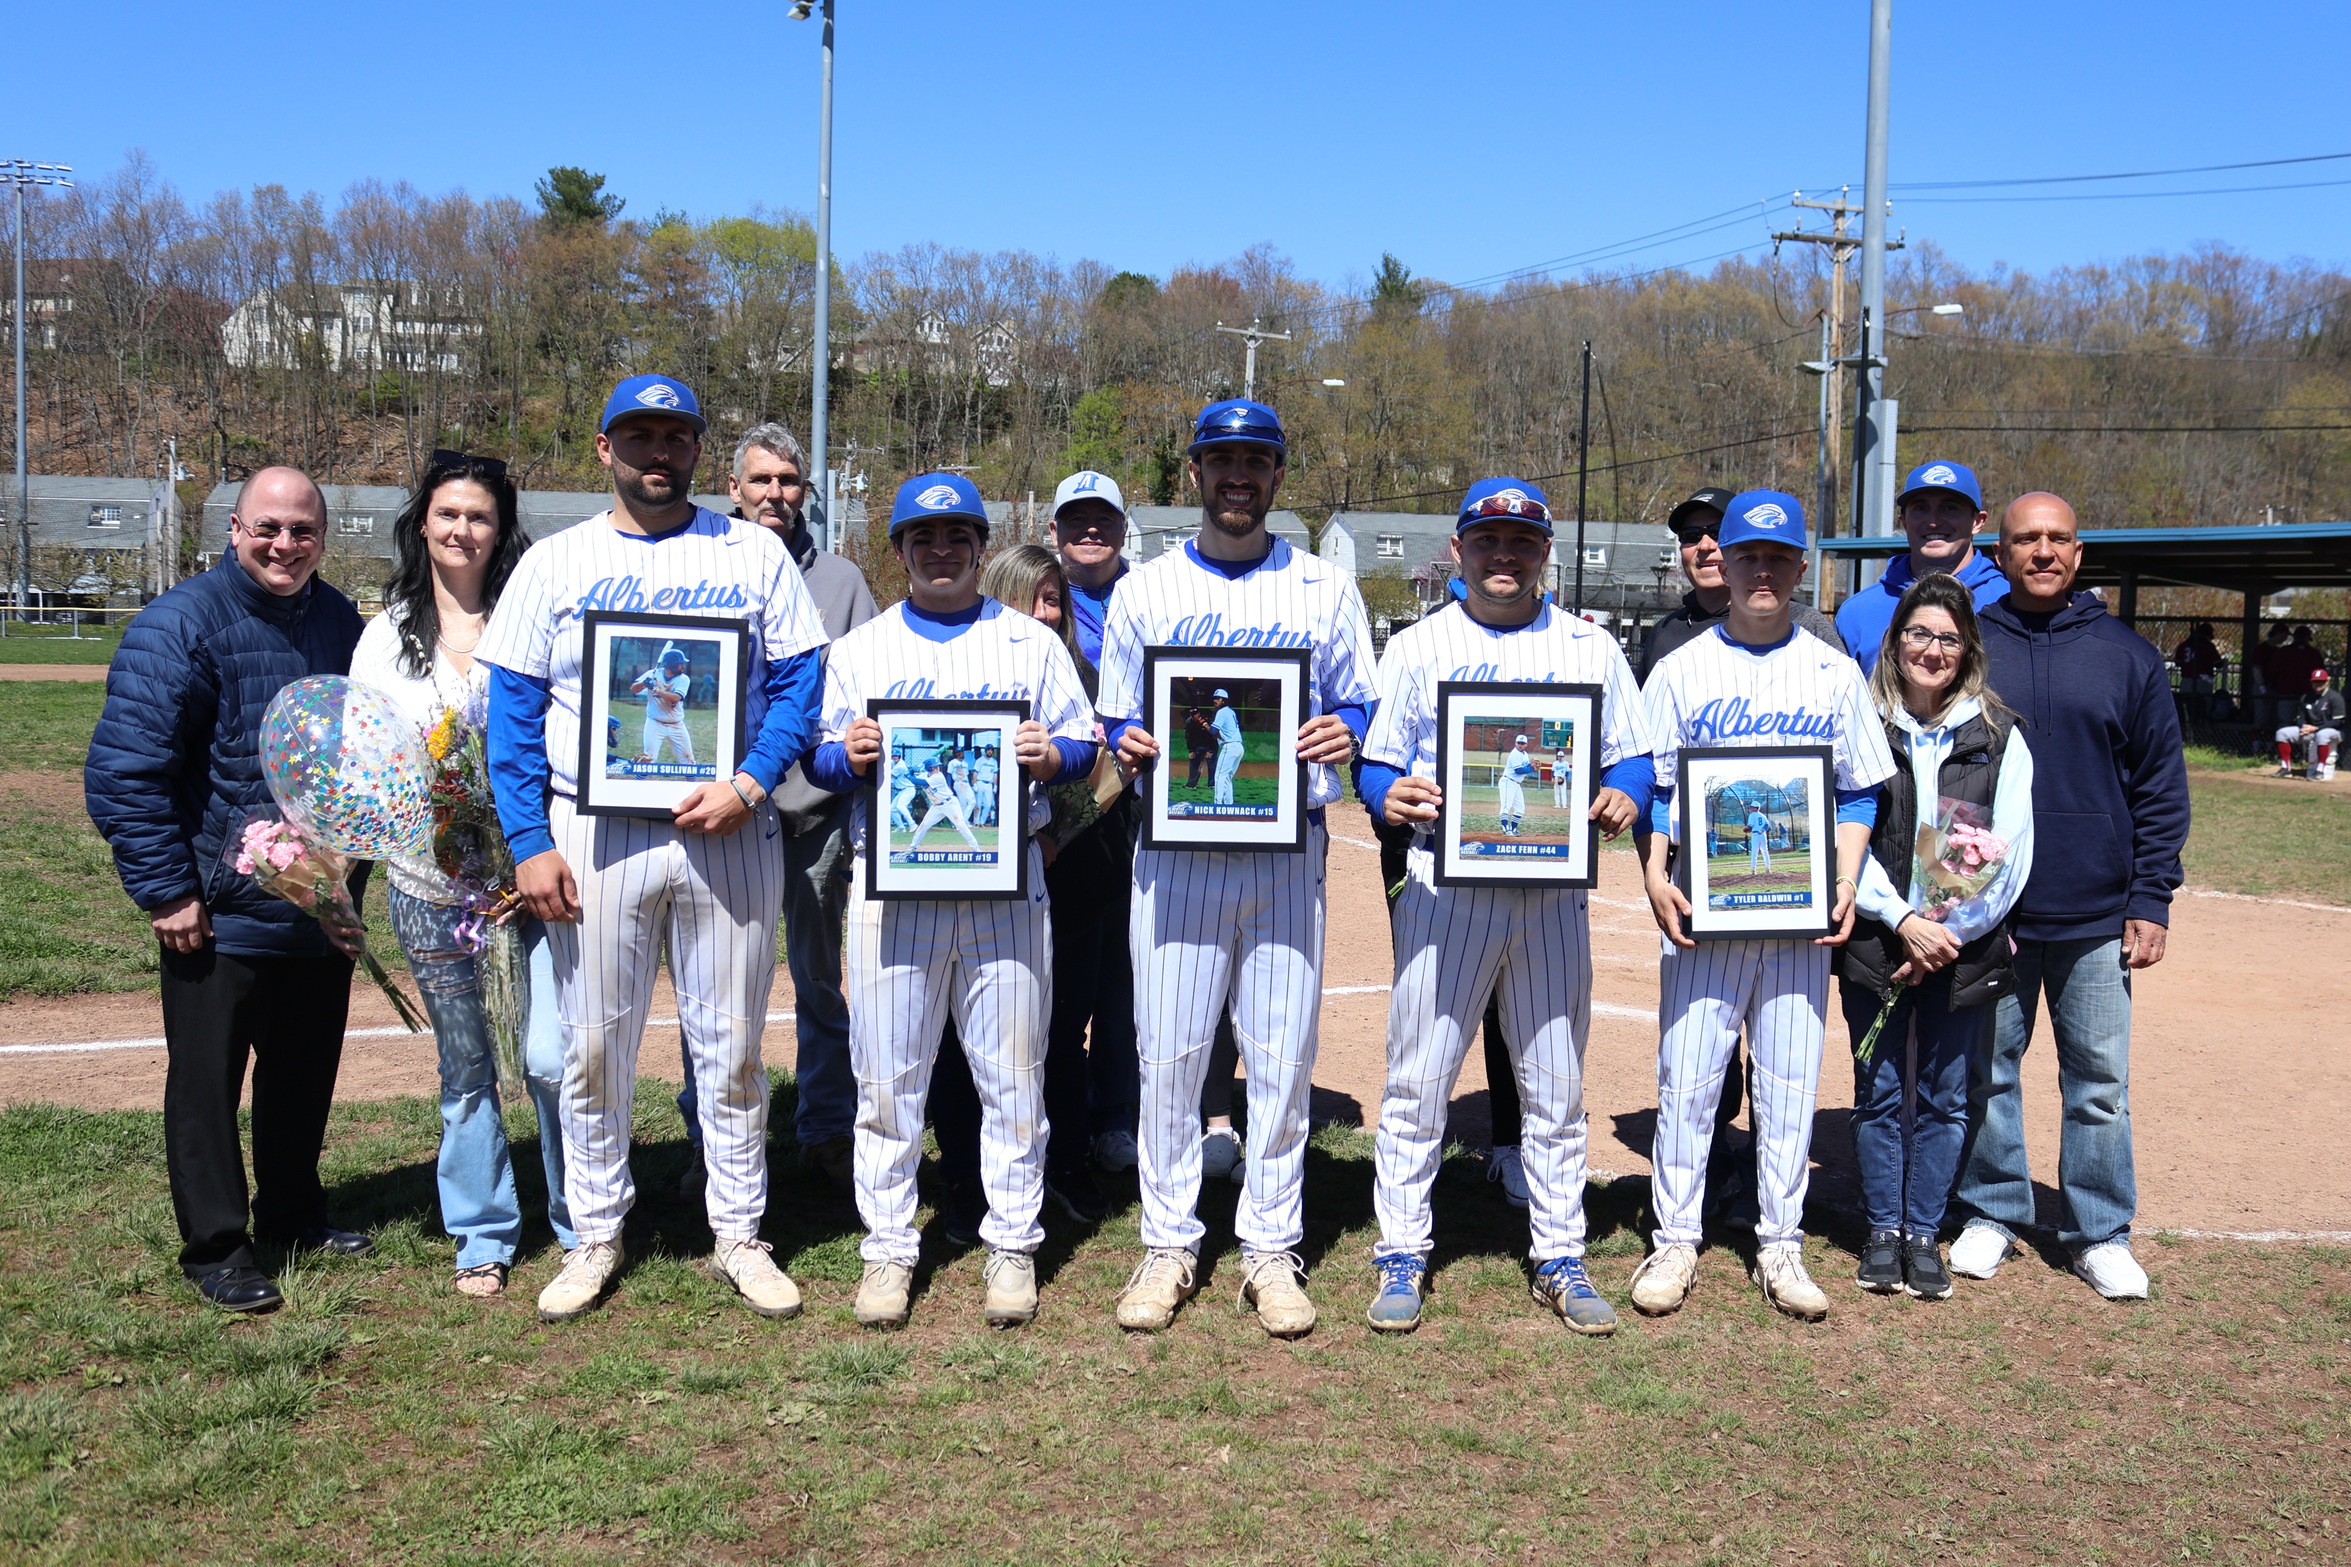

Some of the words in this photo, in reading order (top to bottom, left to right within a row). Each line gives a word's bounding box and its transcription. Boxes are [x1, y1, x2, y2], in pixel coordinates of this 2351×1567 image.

[571, 574, 748, 621] Albertus
[1690, 695, 1835, 742] Albertus
[633, 764, 658, 773] JASON
[660, 764, 698, 775] SULLIVAN
[699, 766, 716, 776] #20
[1194, 805, 1214, 815] NICK
[1216, 806, 1256, 816] KOWNACK
[1258, 807, 1274, 816] #15
[1496, 844, 1517, 854] ZACK
[1519, 845, 1538, 855] FENN
[1540, 846, 1556, 855] #44
[917, 853, 945, 862] BOBBY
[947, 853, 973, 862] ARENT
[975, 853, 992, 862] #19
[1733, 895, 1756, 904] TYLER
[1758, 894, 1792, 903] BALDWIN
[1794, 893, 1804, 902] #1
